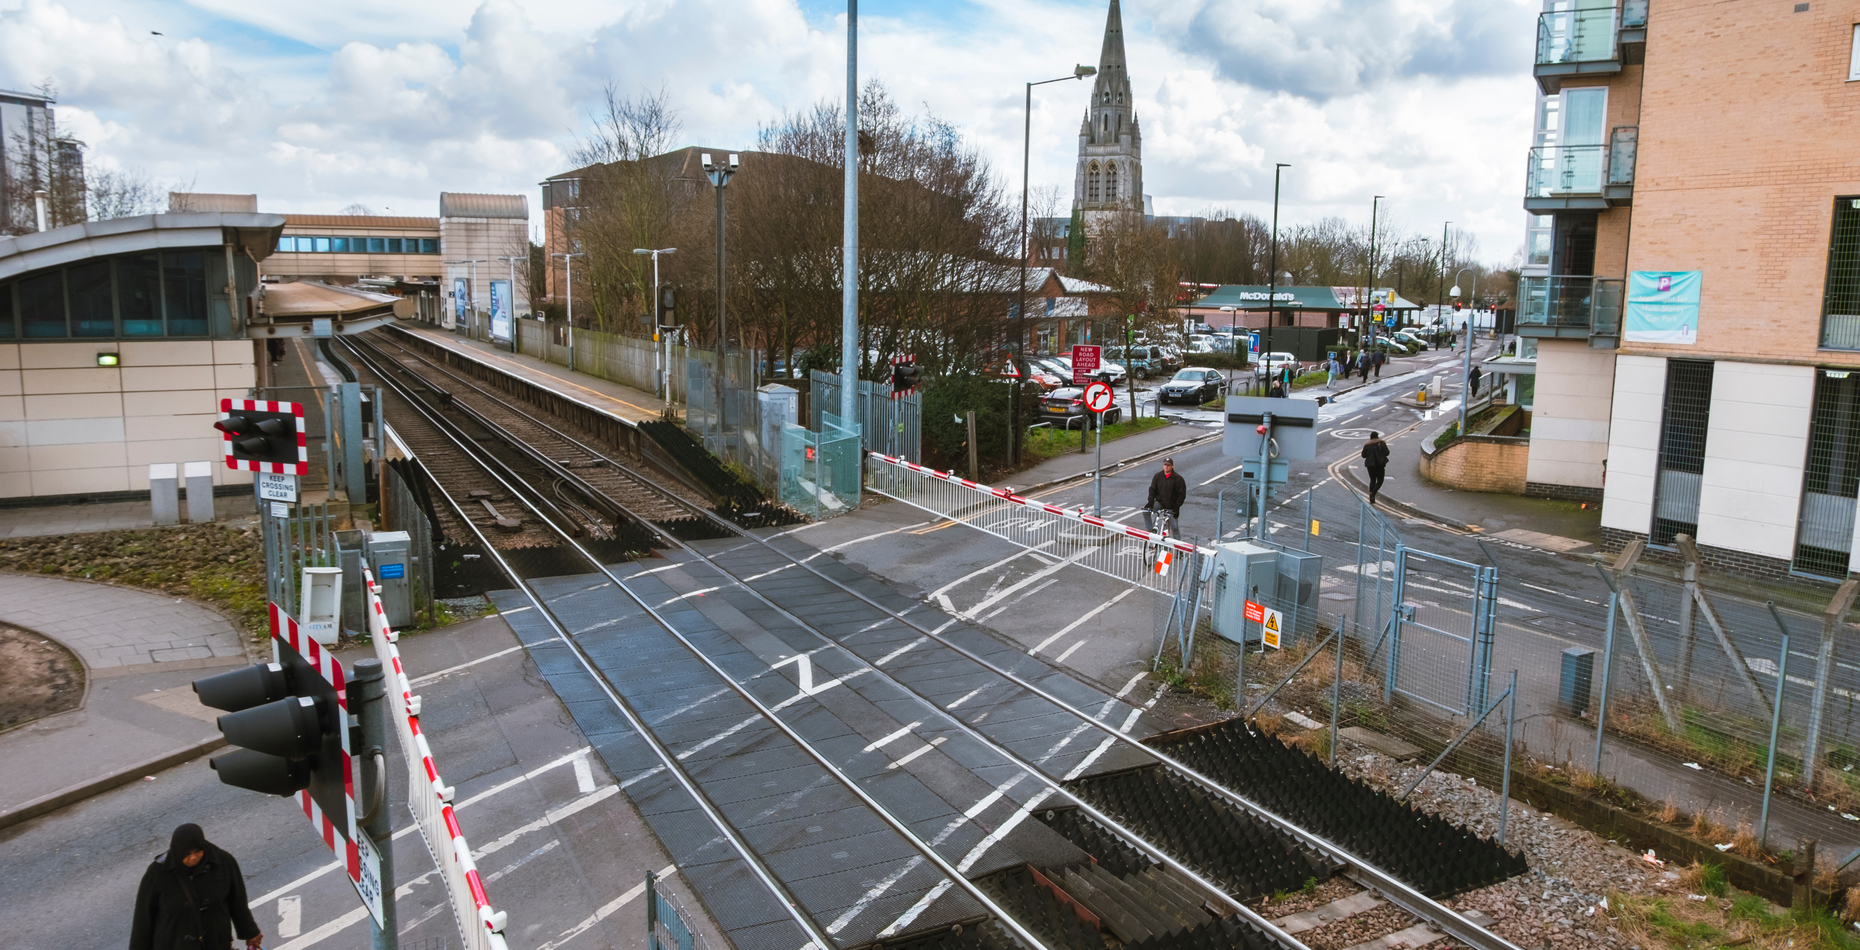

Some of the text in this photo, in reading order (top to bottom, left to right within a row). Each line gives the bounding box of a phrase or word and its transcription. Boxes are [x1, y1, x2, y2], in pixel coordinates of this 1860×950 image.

[1661, 305, 1686, 314] Storey
[1645, 314, 1659, 322] Car
[261, 481, 294, 491] CROSSING
[268, 489, 288, 498] CLEAR
[359, 855, 380, 898] SSING
